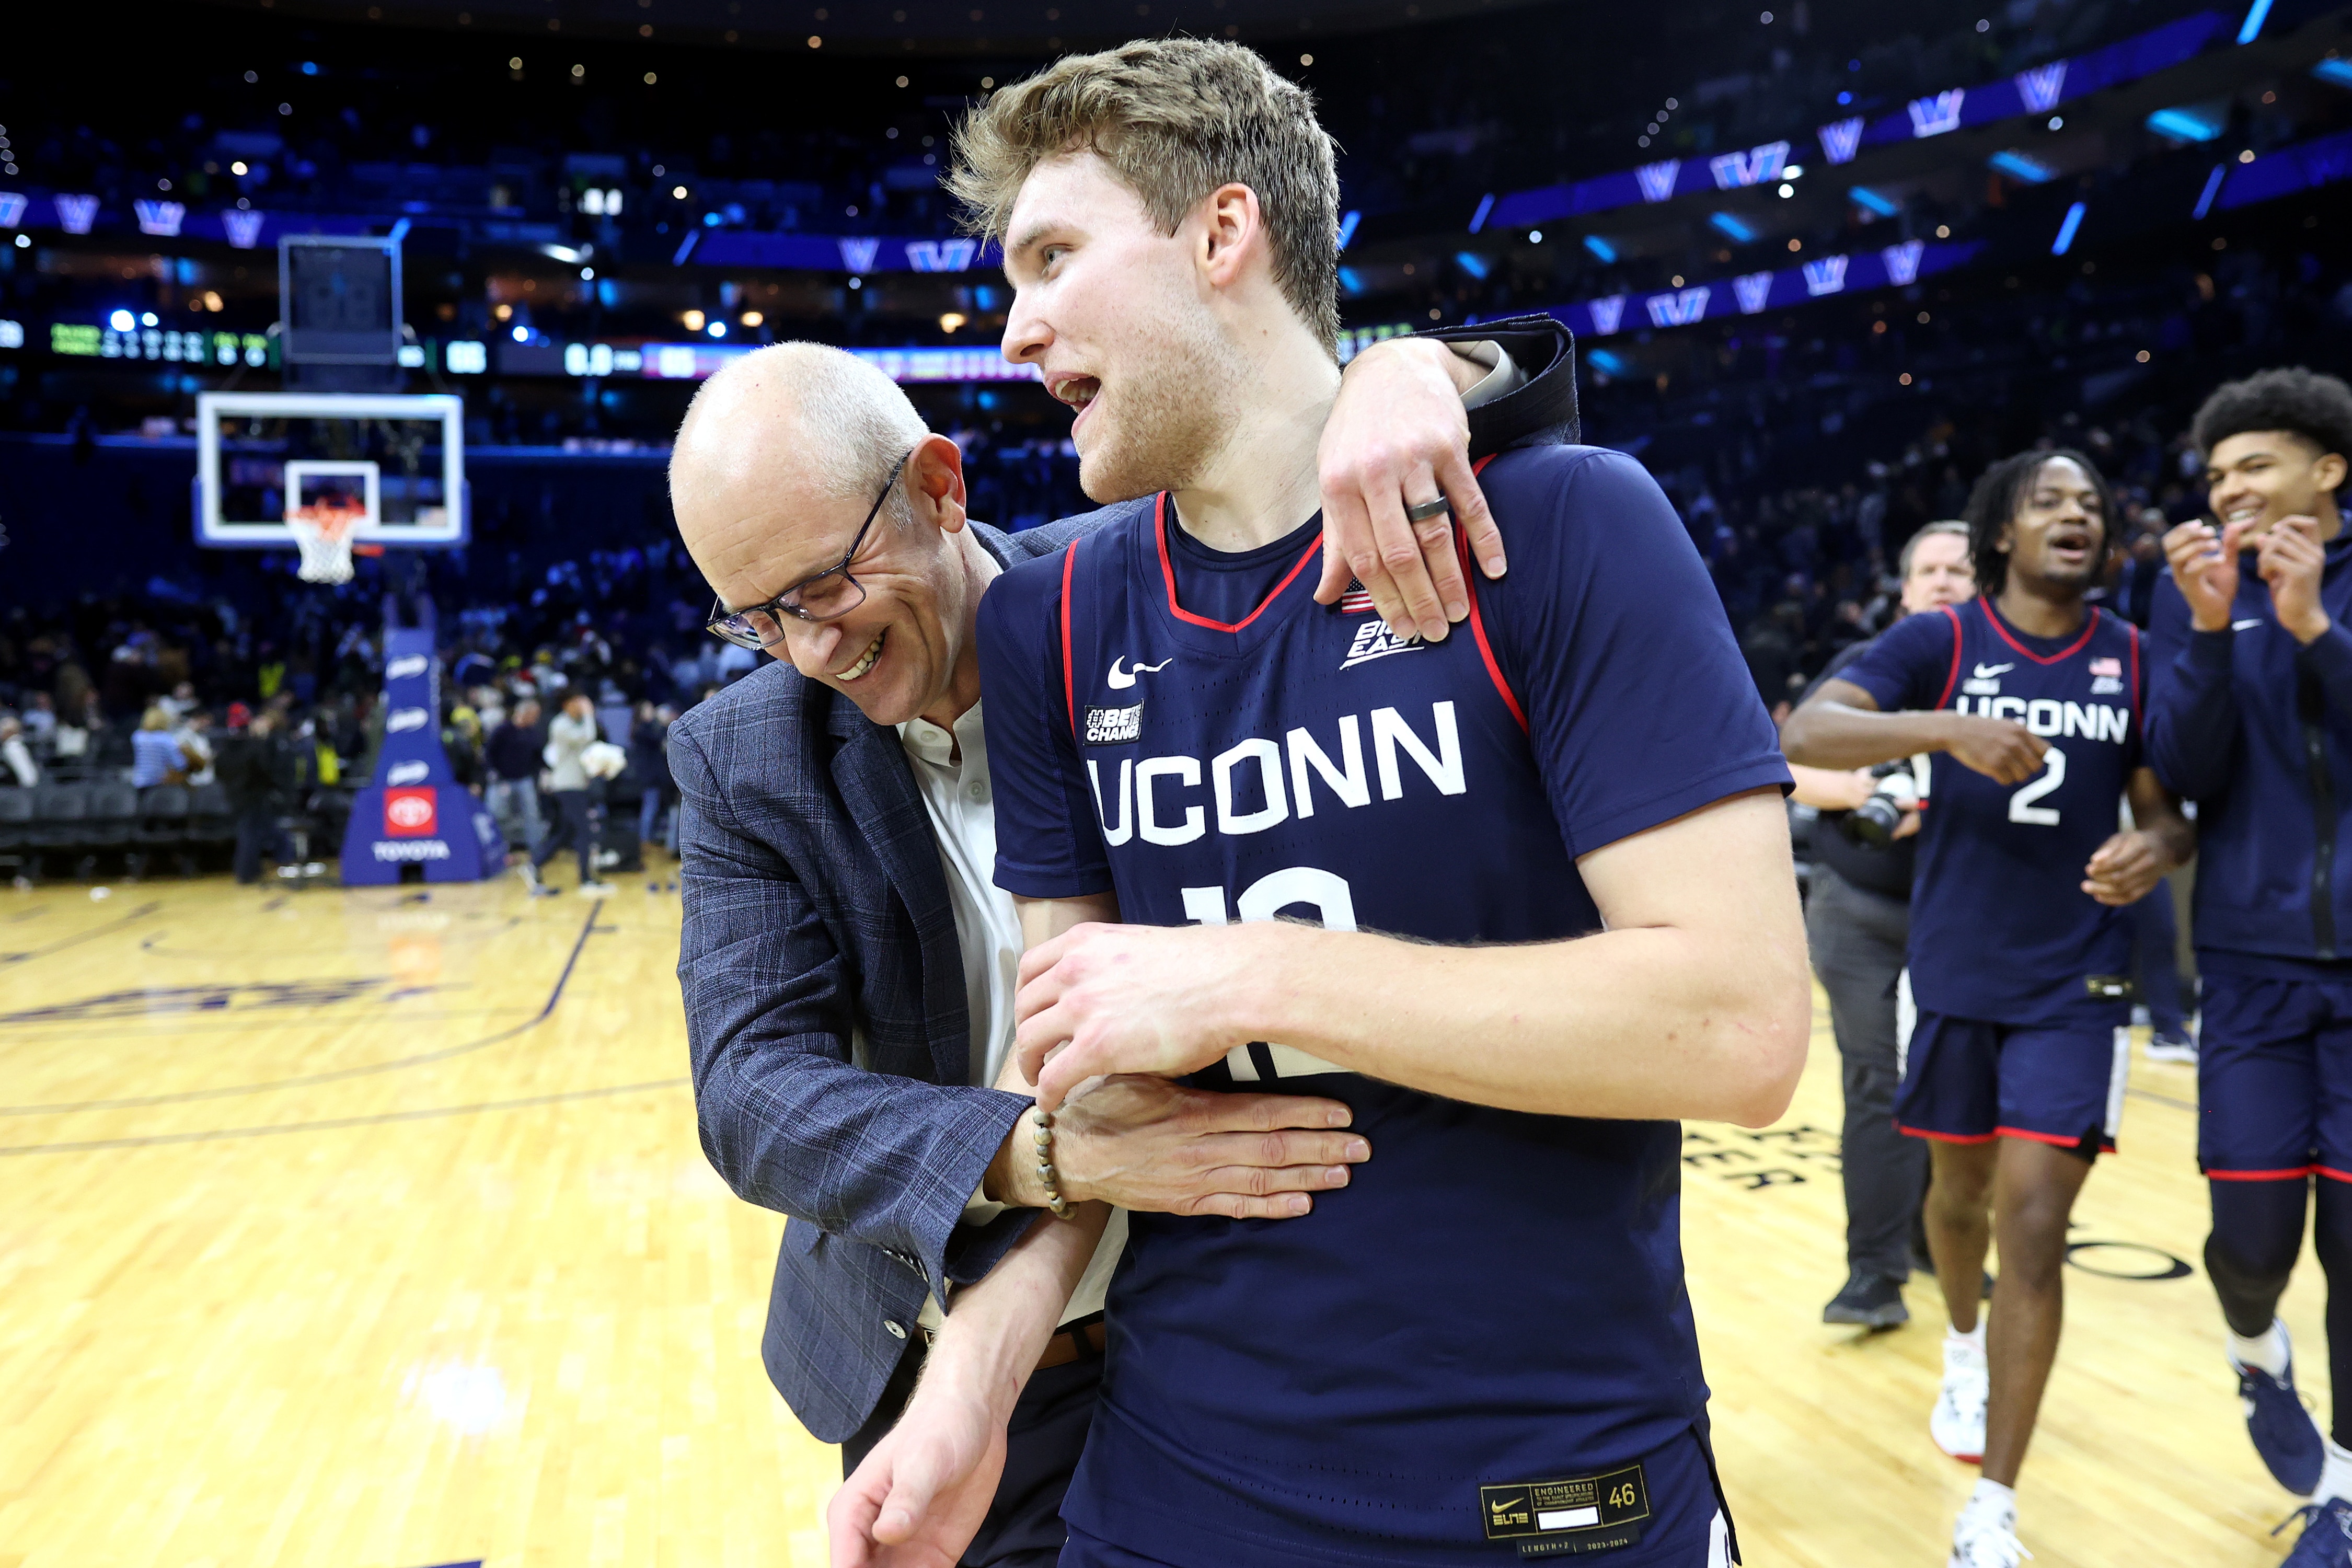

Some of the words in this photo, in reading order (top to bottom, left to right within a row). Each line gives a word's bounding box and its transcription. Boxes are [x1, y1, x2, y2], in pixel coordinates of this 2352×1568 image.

[1956, 695, 2129, 745] UCONN
[1087, 700, 1466, 847] UCONN
[2008, 747, 2066, 826] 2
[1535, 1483, 1593, 1496] ENGINEERED
[1609, 1482, 1636, 1509] 46
